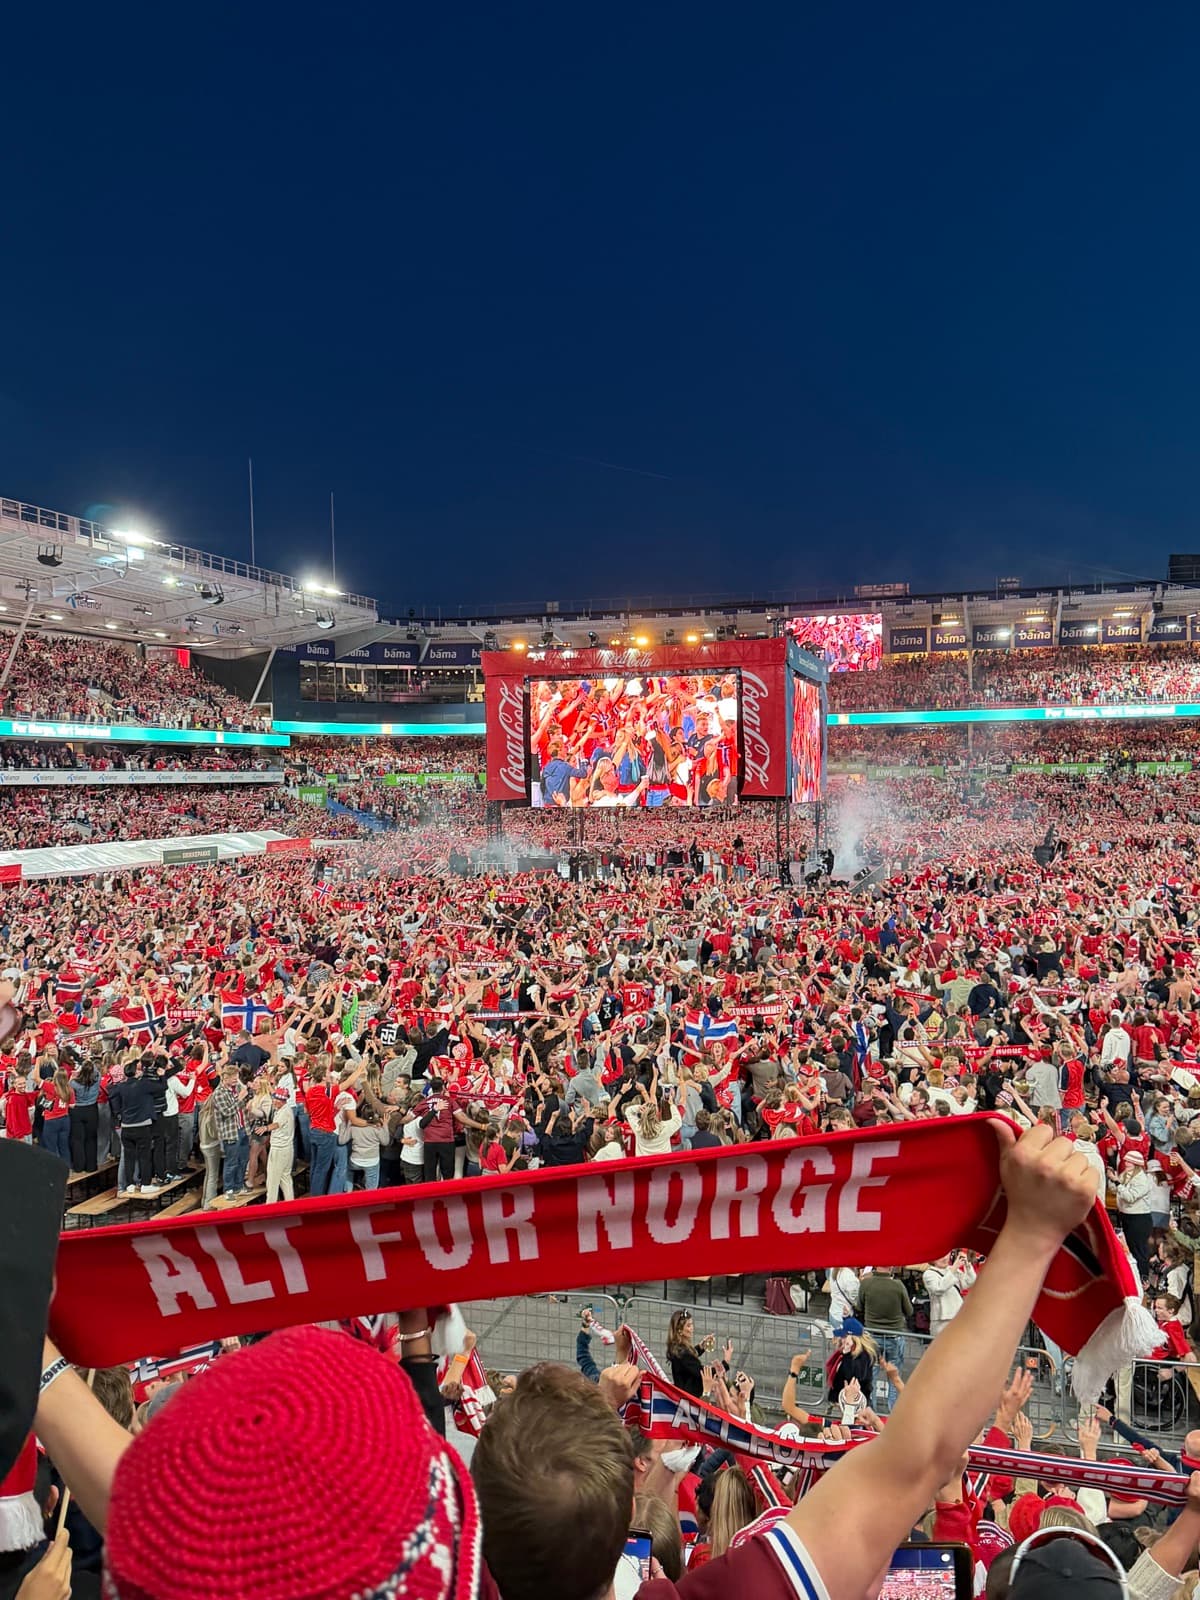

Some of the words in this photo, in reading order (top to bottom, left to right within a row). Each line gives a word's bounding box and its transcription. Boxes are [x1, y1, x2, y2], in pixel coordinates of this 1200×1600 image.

[130, 1216, 309, 1317] ALT
[350, 1192, 540, 1283] FOR
[576, 1141, 902, 1256] NORGE
